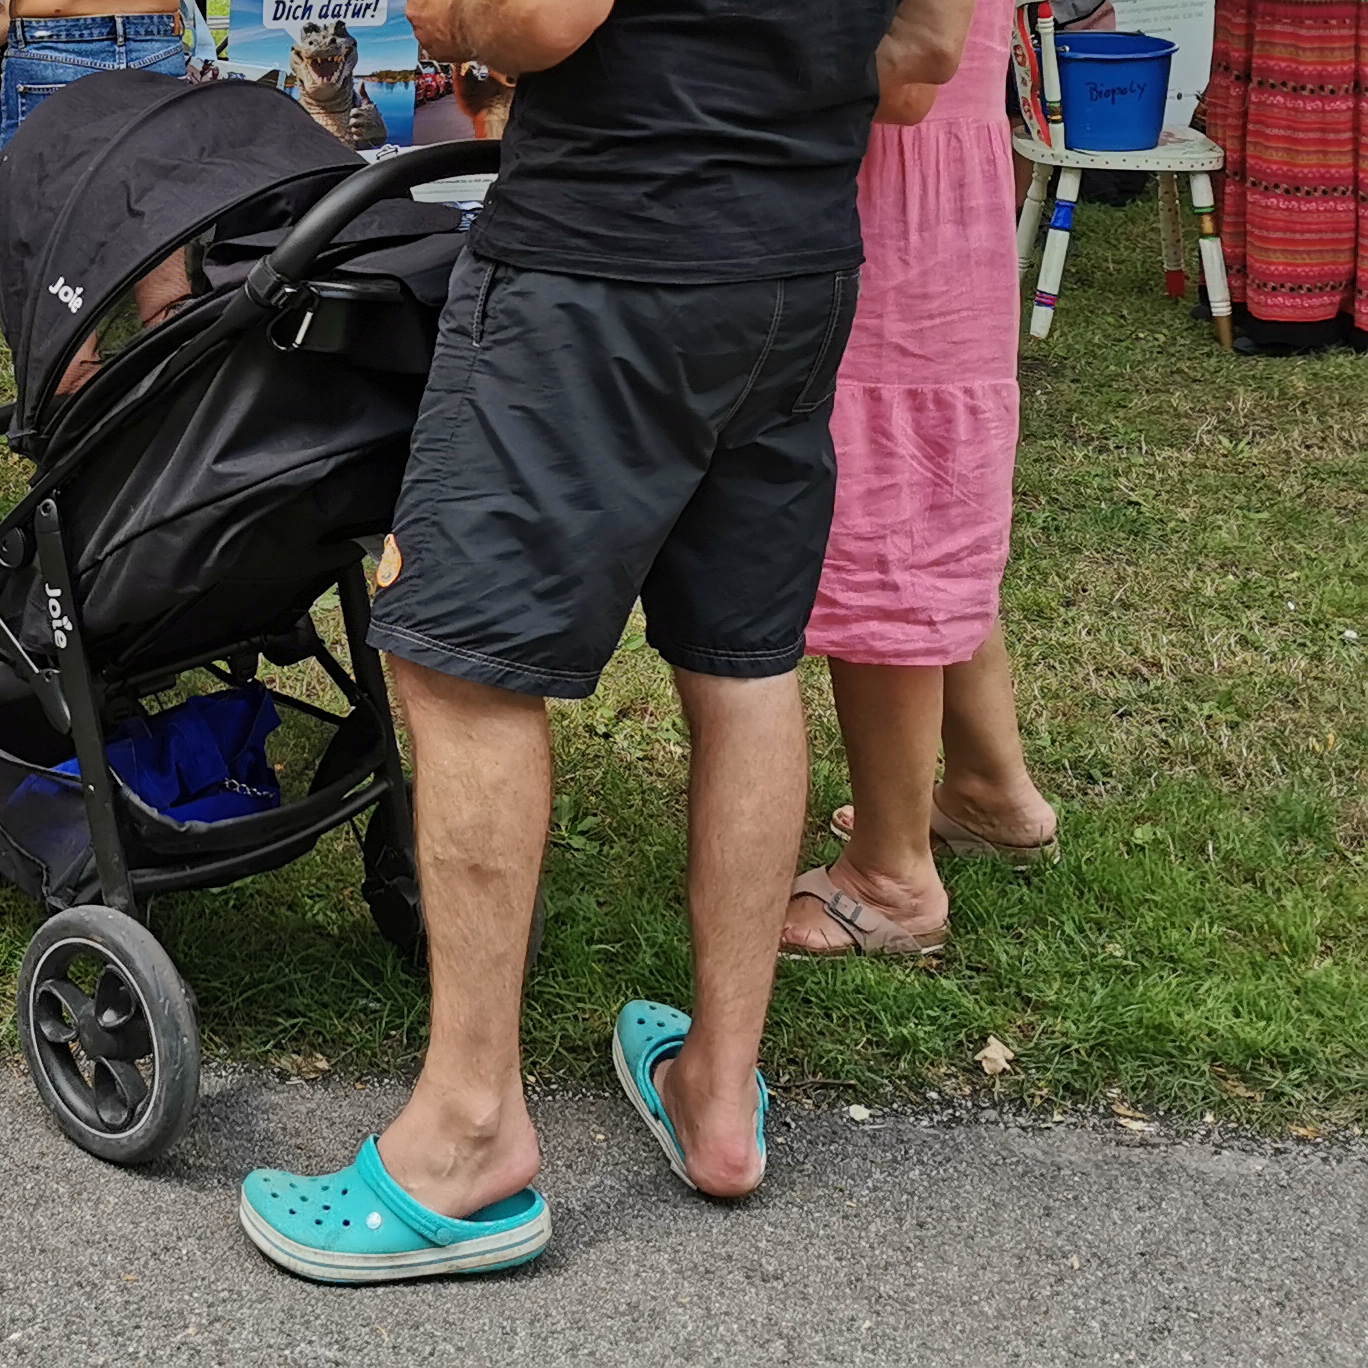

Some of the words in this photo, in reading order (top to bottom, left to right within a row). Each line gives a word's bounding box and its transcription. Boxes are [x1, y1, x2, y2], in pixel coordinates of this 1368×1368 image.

[272, 0, 313, 22] Dich
[1085, 81, 1147, 105] Biopoly
[48, 276, 84, 314] Joie
[45, 582, 73, 650] Joie
